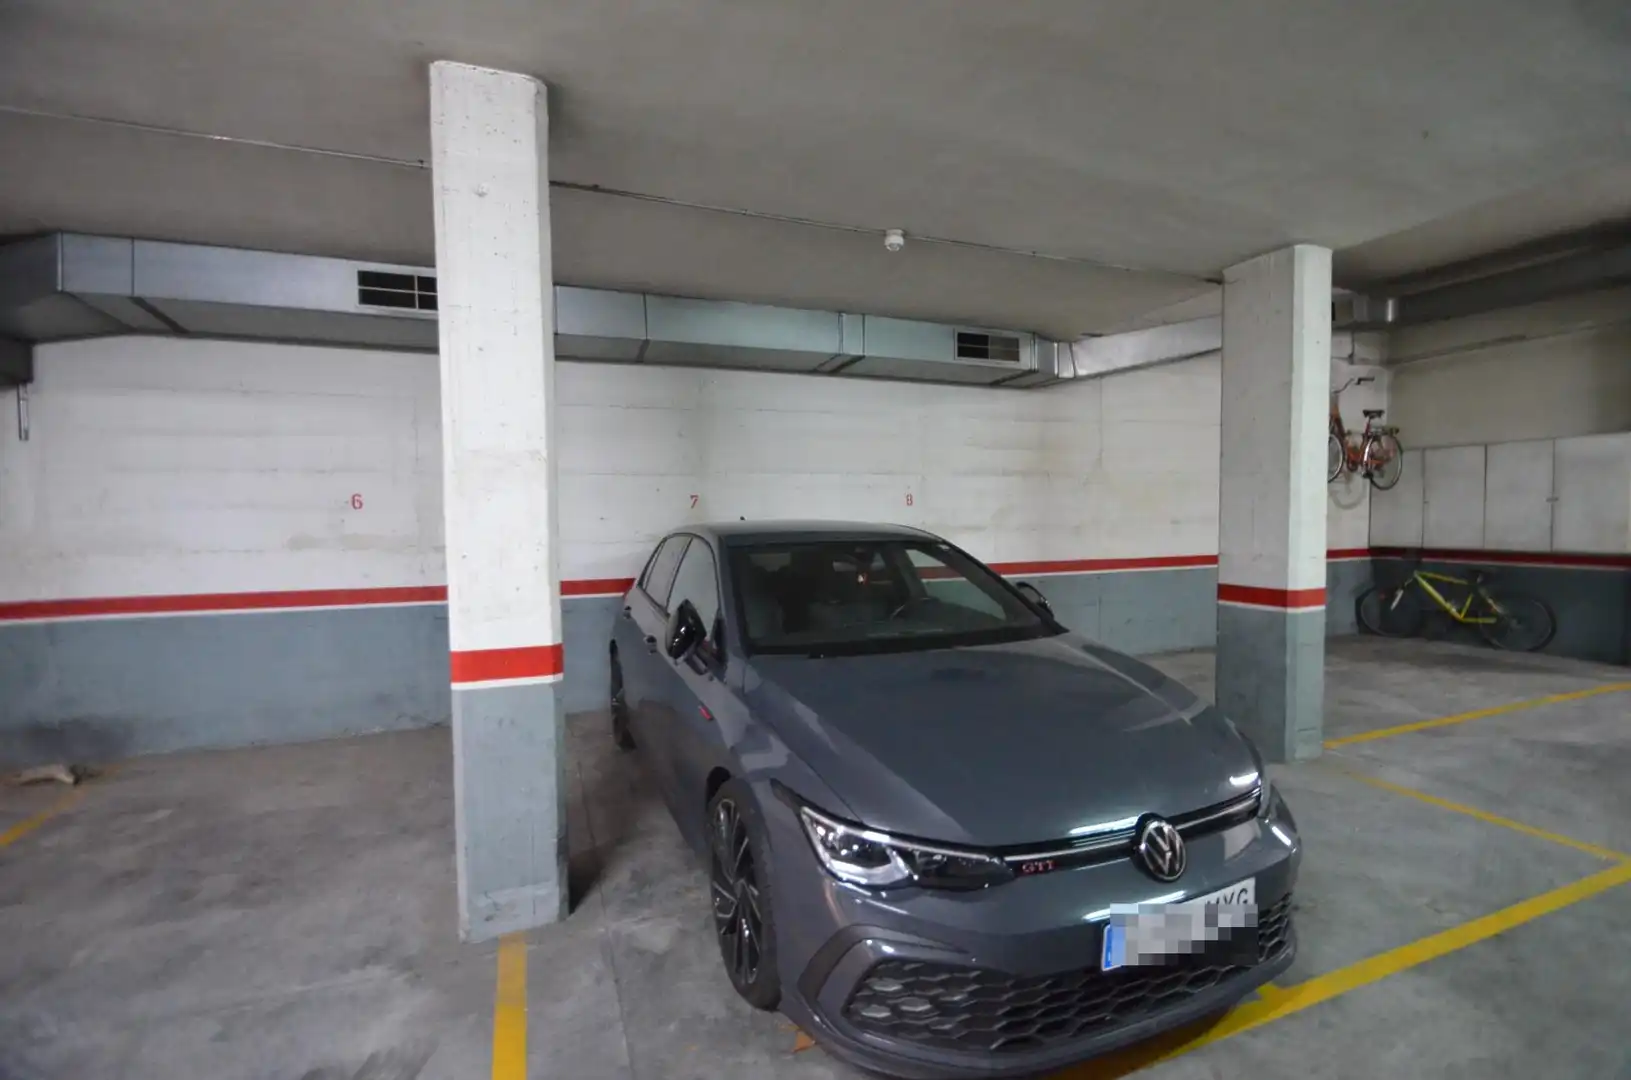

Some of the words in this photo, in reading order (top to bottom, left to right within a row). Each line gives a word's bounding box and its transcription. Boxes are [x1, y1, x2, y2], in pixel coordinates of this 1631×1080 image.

[350, 493, 364, 510] 6
[690, 494, 699, 509] 7
[1022, 860, 1053, 873] GTI
